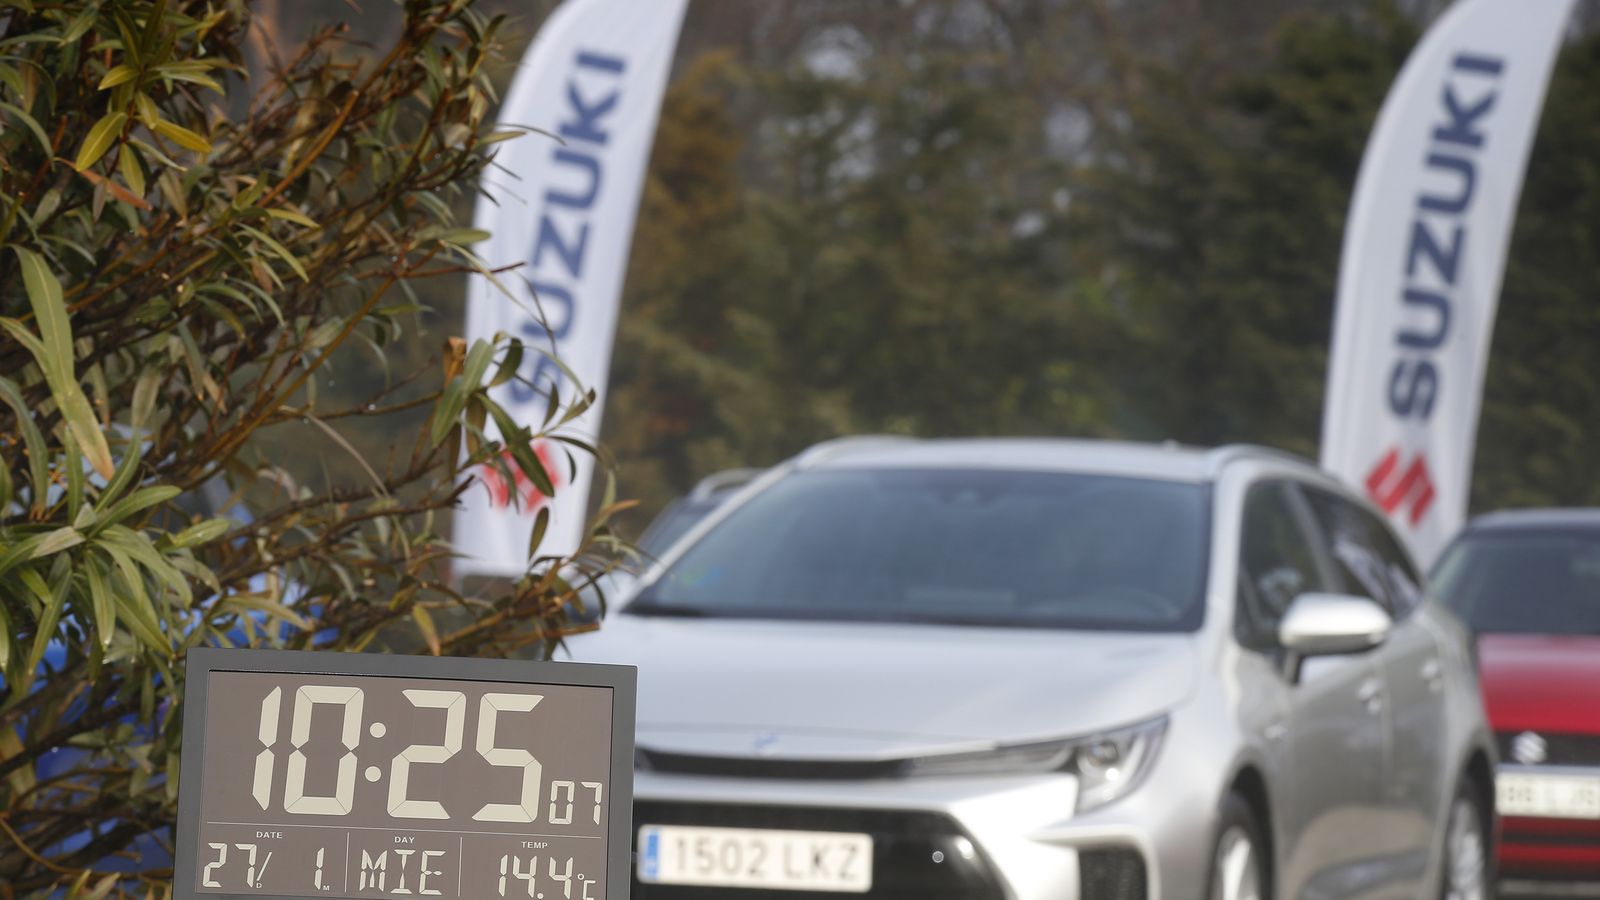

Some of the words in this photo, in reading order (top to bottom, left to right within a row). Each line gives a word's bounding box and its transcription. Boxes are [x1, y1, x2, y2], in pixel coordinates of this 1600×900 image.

[505, 49, 628, 406] SUZUKI
[1387, 50, 1506, 422] SUZUKI
[252, 685, 544, 824] 10:25
[548, 780, 602, 825] 07
[256, 831, 283, 839] DATE
[394, 836, 415, 844] DAY
[521, 841, 548, 849] TEMP
[359, 849, 446, 896] MIE
[674, 836, 769, 877] 1502
[783, 841, 860, 881] LKZ
